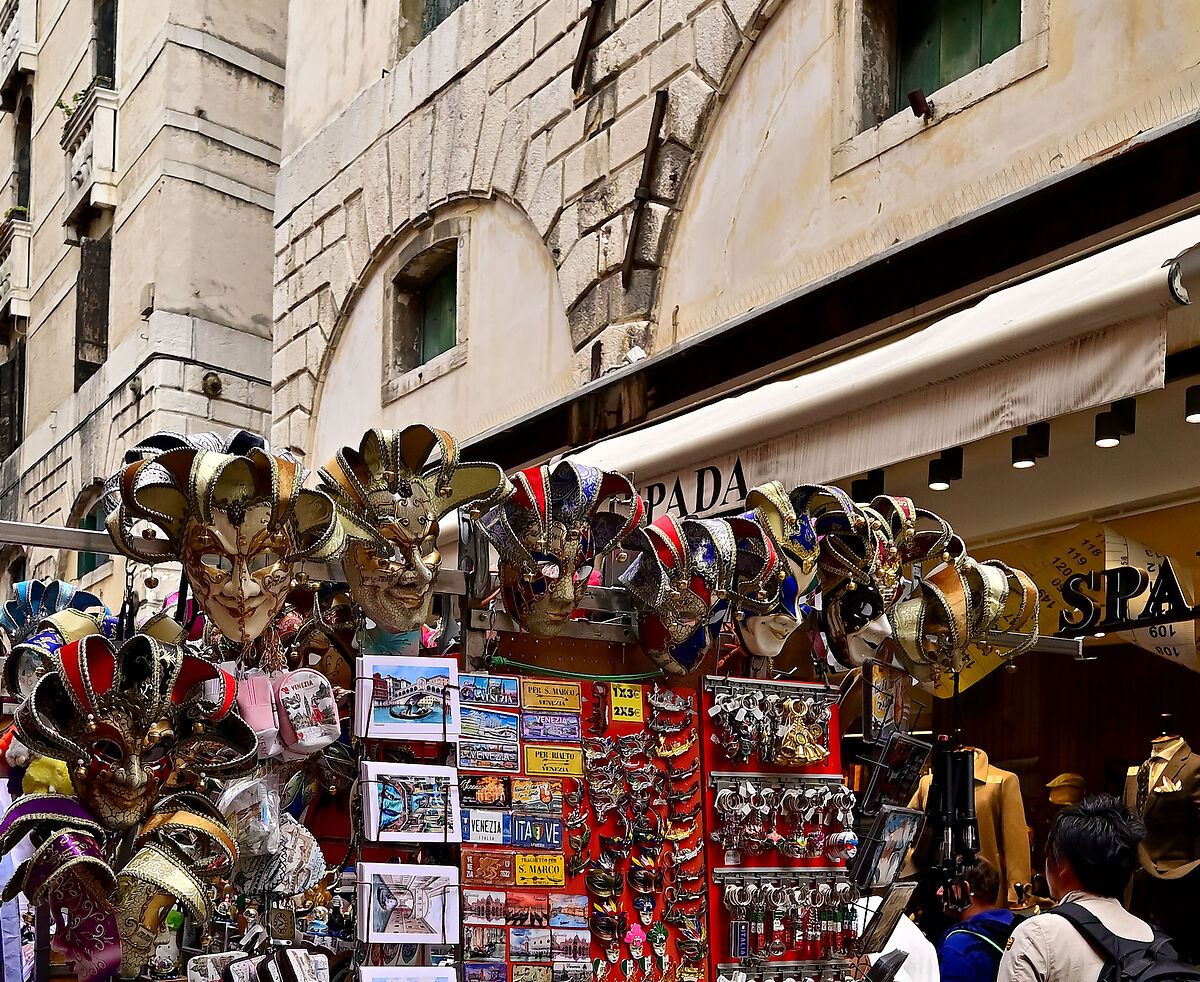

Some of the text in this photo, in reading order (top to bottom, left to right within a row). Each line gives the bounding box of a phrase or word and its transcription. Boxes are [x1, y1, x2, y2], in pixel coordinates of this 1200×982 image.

[639, 456, 748, 525] PADA
[1067, 547, 1088, 566] 119
[1052, 557, 1072, 576] 120
[1149, 624, 1176, 638] 109
[528, 686, 541, 694] PER
[536, 716, 567, 724] VENEZIA
[471, 819, 501, 833] VENEZIA
[515, 820, 560, 844] ITA VE
[529, 865, 560, 874] MARCO
